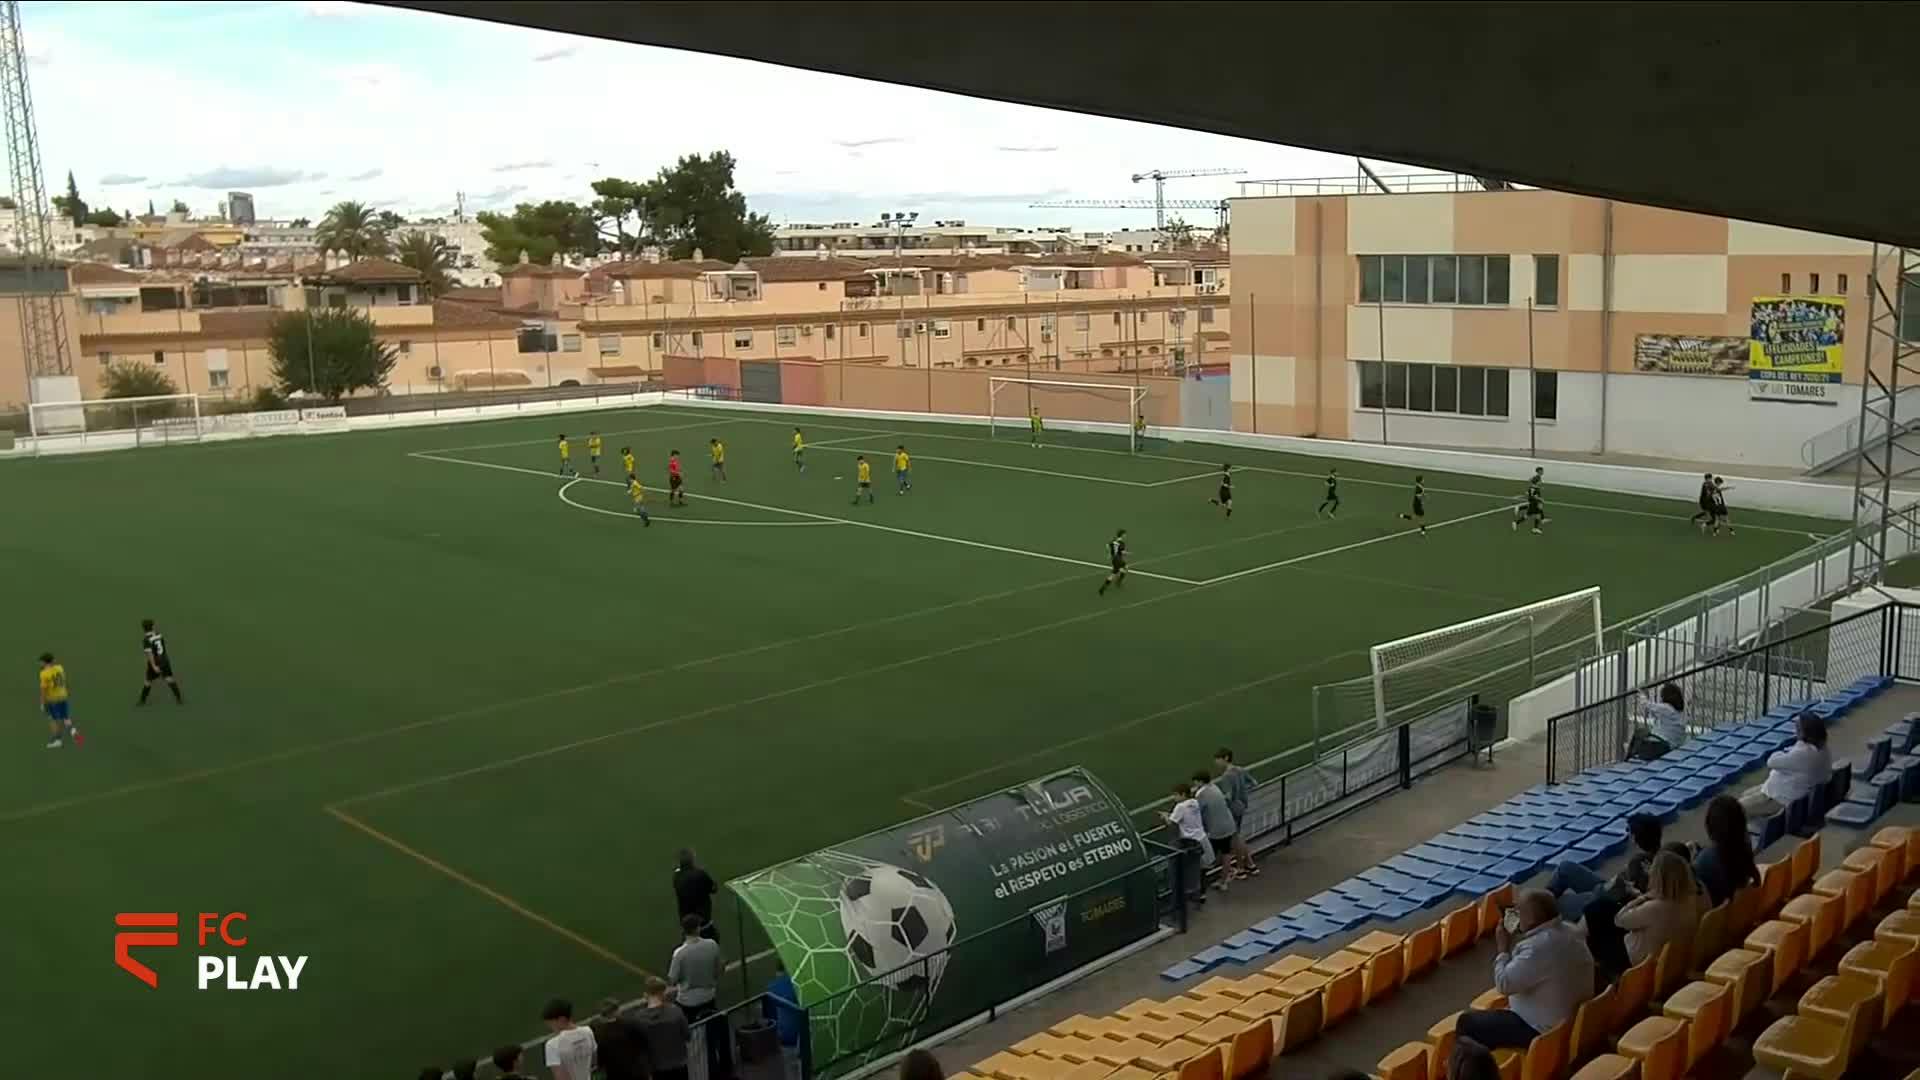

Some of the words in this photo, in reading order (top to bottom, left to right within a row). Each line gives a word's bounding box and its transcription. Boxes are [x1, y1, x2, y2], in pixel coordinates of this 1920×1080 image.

[1785, 384, 1825, 397] TOMARES
[990, 863, 1010, 878] La
[994, 882, 1011, 899] el
[1008, 861, 1068, 894] RESPETO
[1068, 857, 1085, 872] es
[1083, 837, 1133, 866] ETERNO
